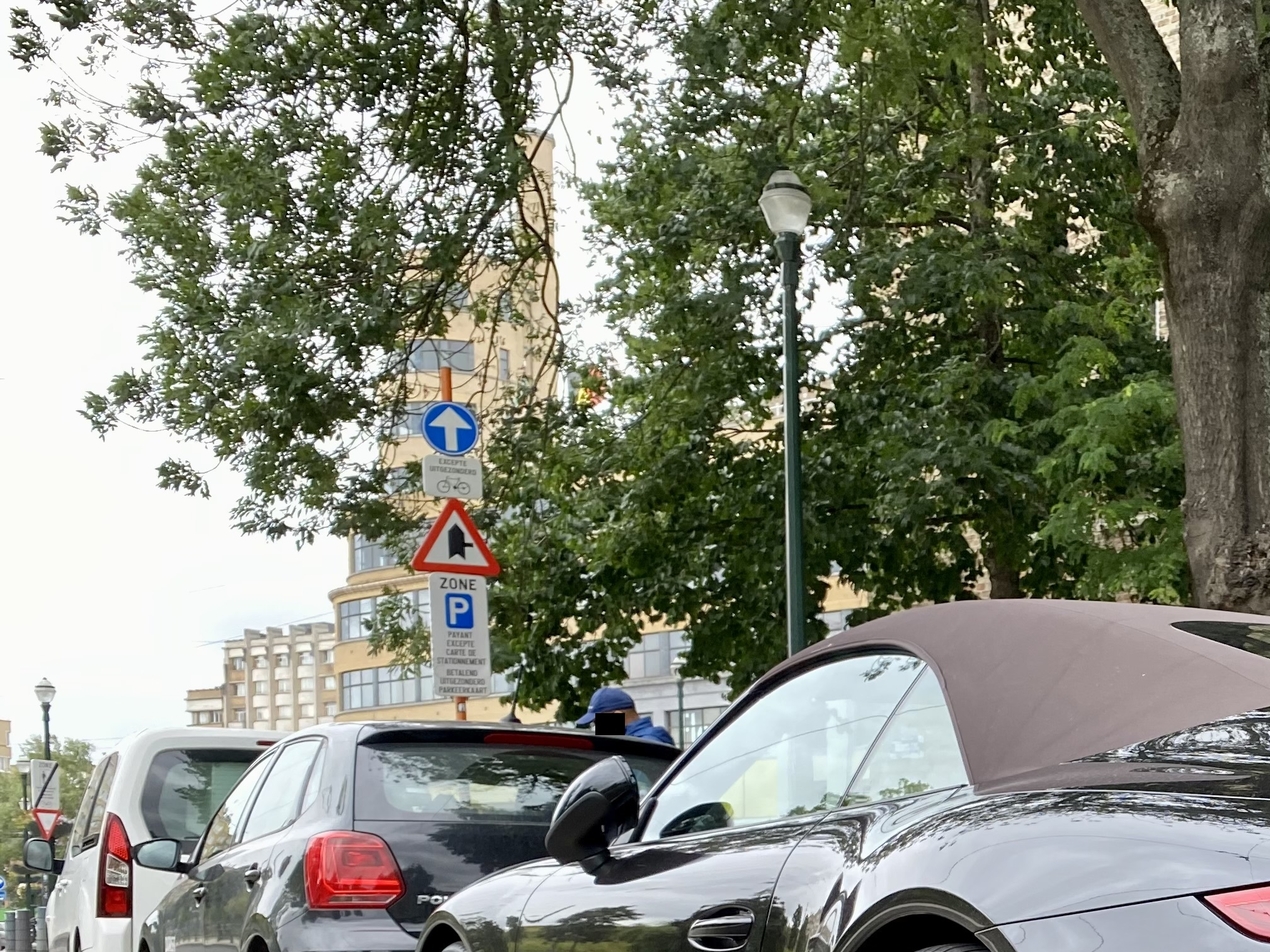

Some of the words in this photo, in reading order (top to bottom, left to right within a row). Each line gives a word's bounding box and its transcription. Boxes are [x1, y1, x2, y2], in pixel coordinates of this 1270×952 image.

[440, 577, 477, 591] ZONE
[449, 596, 469, 625] P
[447, 631, 473, 639] PAYANT
[468, 649, 477, 657] DE
[437, 657, 486, 665] STATIONNEMENT
[446, 669, 478, 677] BETALEND
[440, 677, 485, 685] UITGEZONDERD
